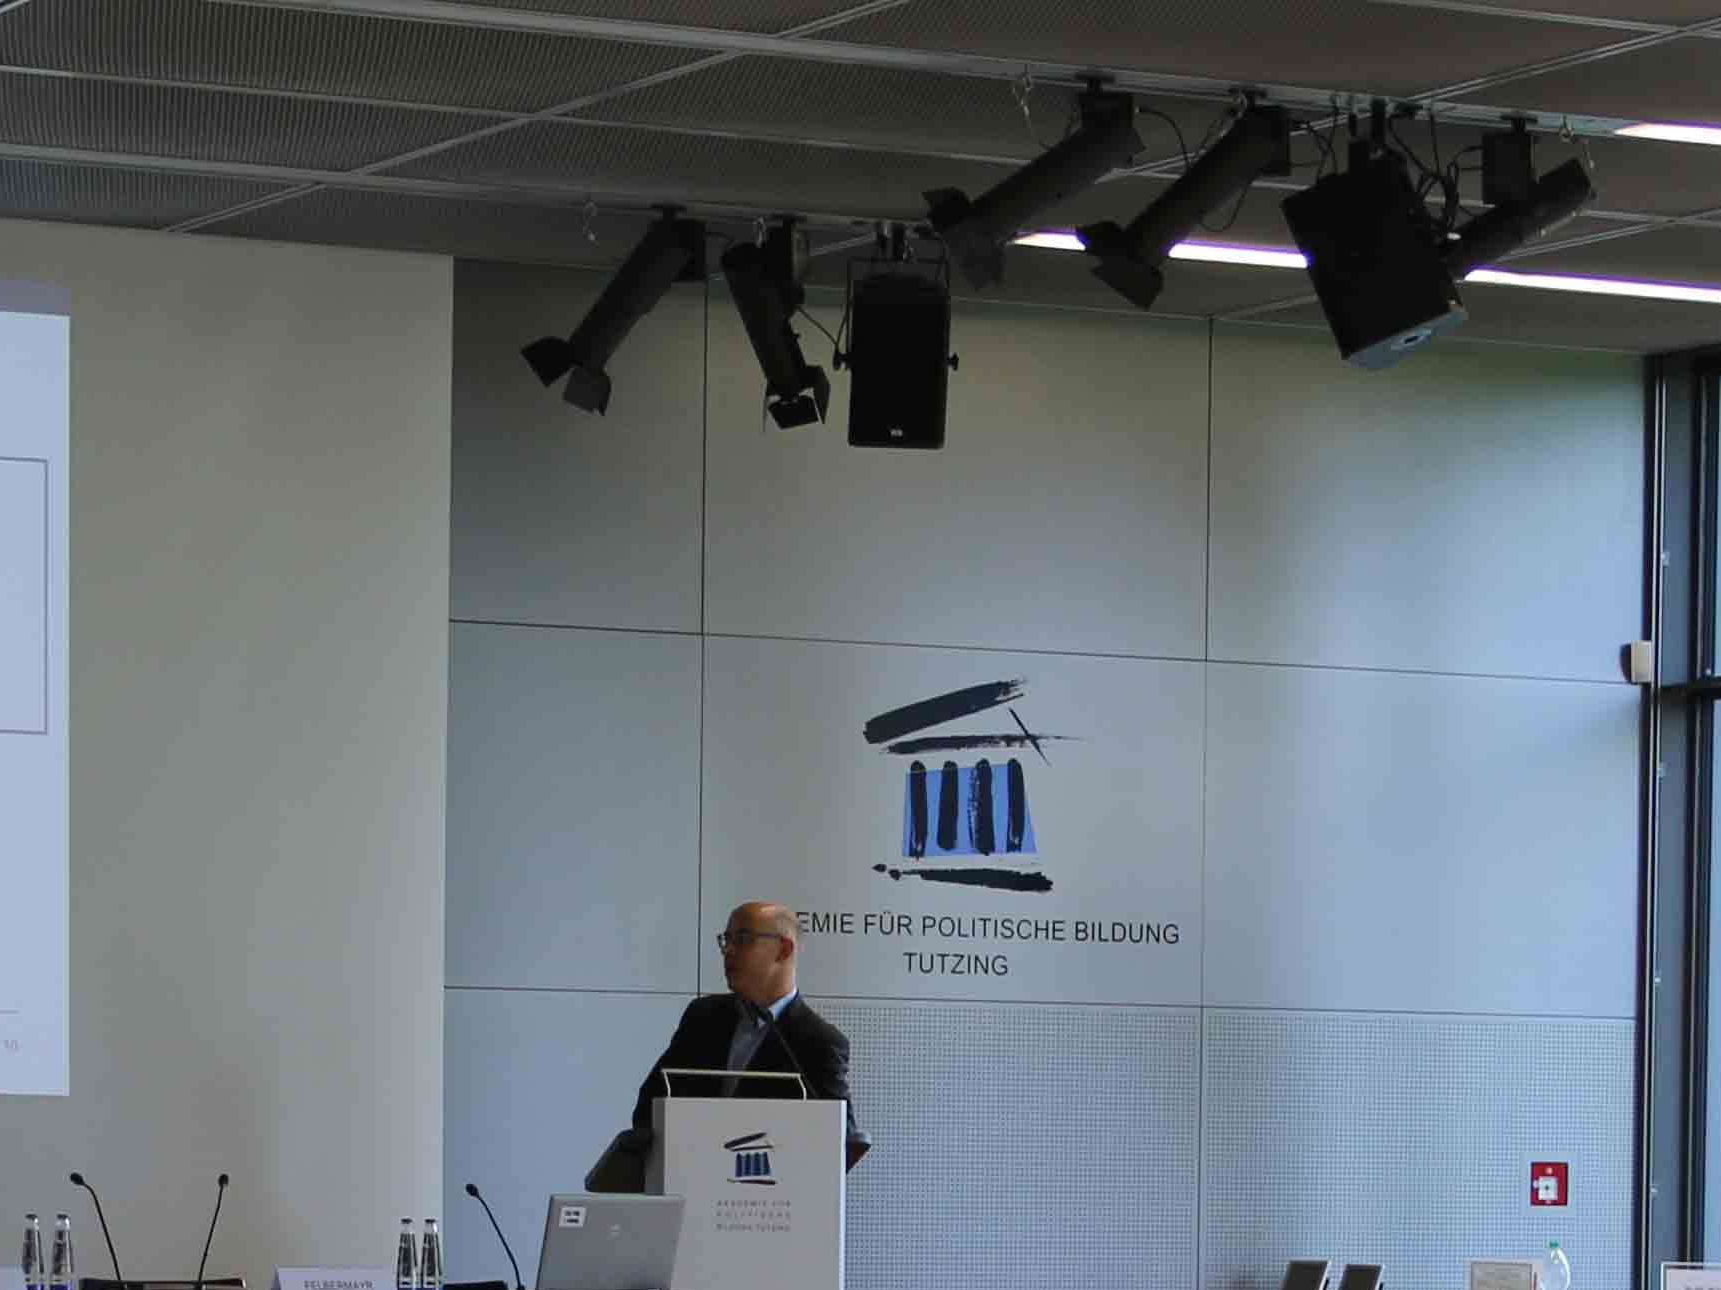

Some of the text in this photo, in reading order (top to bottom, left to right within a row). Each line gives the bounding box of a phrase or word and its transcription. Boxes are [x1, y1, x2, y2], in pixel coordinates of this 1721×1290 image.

[795, 911, 1181, 945] EMIE FÜR POLITISCHE BILDUNG
[902, 951, 1009, 976] TUTZING
